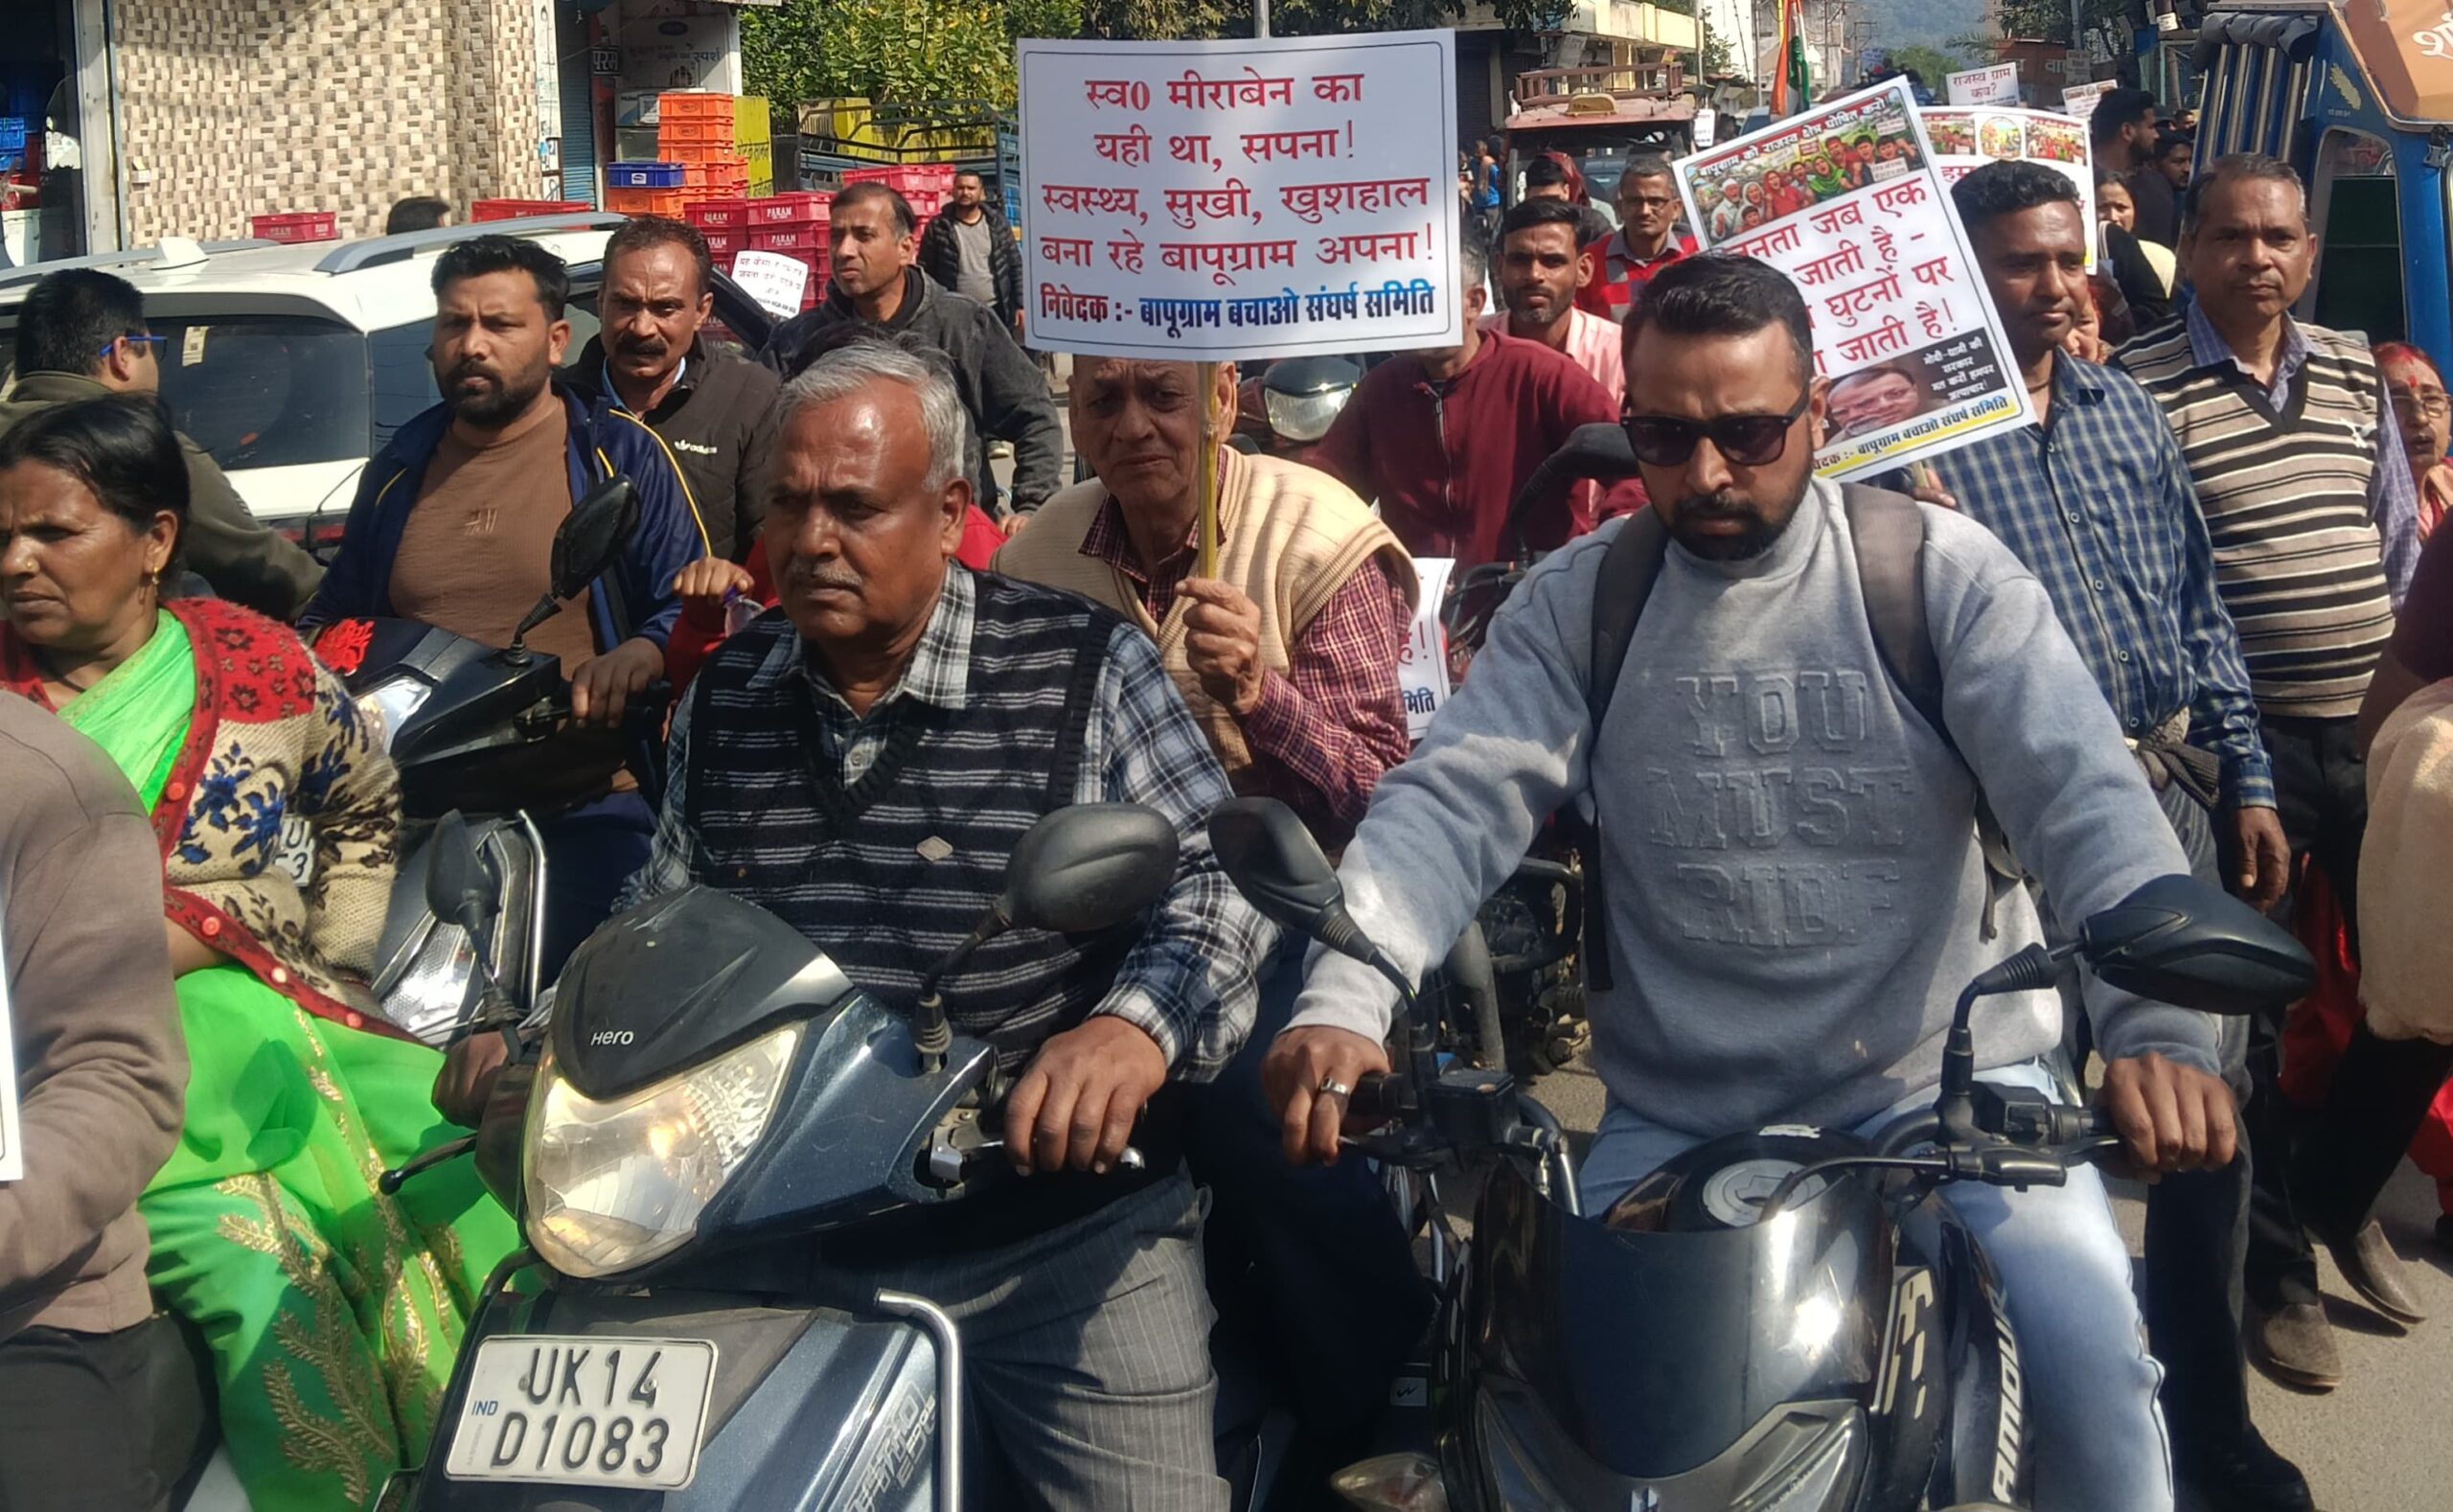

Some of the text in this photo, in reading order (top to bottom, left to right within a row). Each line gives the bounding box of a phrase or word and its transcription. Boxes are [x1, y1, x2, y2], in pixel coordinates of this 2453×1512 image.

[1166, 66, 1294, 110] मीराबेन
[1312, 74, 1364, 103] का
[1953, 67, 2011, 86] राजस्व ग्राम
[1094, 123, 1153, 168] यही
[1169, 134, 1223, 172] था,
[1164, 178, 1262, 229] सुखी,
[1280, 177, 1432, 224] खुशहाल
[1810, 200, 1866, 237] जब
[1872, 176, 1927, 218] एक
[1040, 237, 1093, 268] बना
[1108, 229, 1145, 275] रहे
[1159, 240, 1297, 286] बापूग्राम
[1793, 242, 1866, 286] जाती
[1871, 225, 1899, 263] है
[1139, 297, 1222, 338] बापूग्राम
[1227, 287, 1300, 328] बचाओ
[1306, 282, 1359, 321] संघर्ष
[1365, 278, 1435, 318] समिति
[1824, 266, 1903, 328] घुटनों
[1911, 256, 1956, 286] पर
[1836, 314, 1910, 362] जाती
[1404, 687, 1435, 714] मिति
[1676, 671, 1868, 756] YOU
[1646, 767, 1916, 848] MUST
[1678, 859, 1909, 947] RIDE
[471, 1400, 498, 1416] IND
[491, 1411, 670, 1475] D1083
